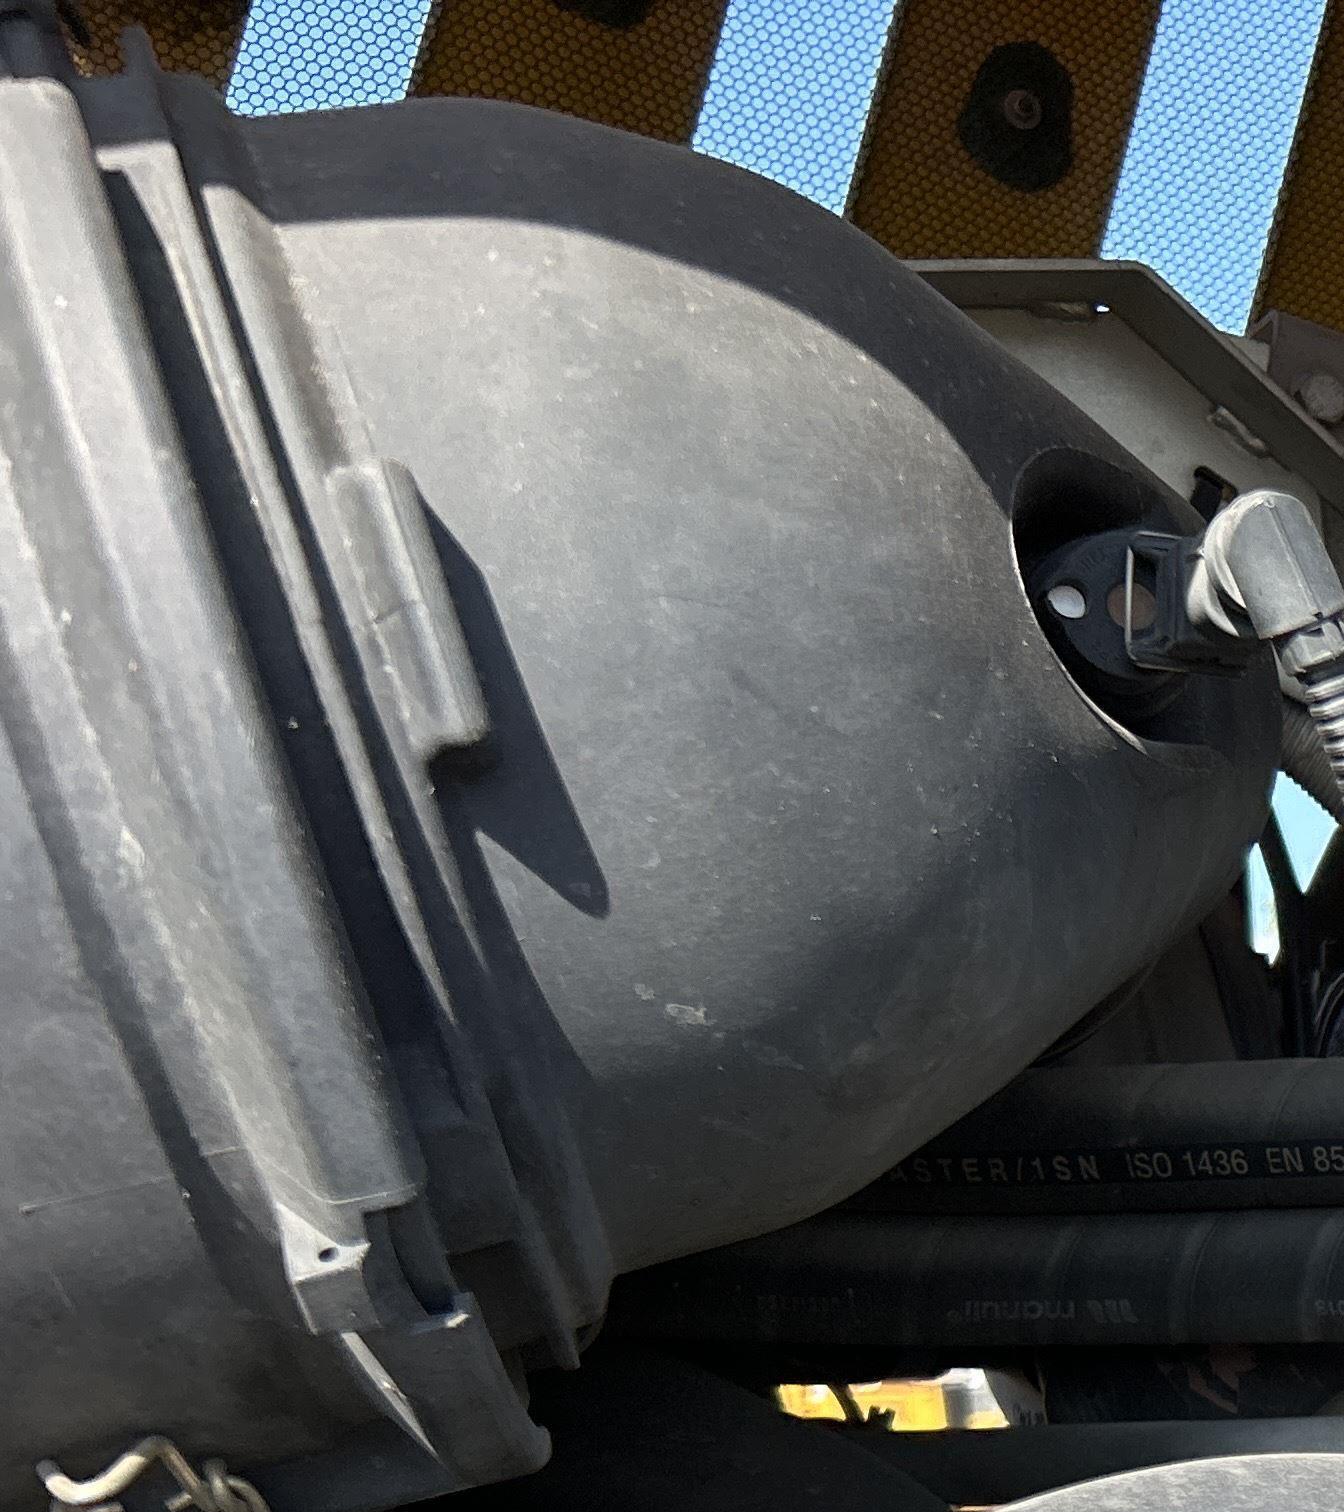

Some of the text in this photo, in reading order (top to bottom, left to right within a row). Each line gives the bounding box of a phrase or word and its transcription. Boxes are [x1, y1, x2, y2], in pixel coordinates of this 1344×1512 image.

[888, 1152, 1100, 1184] ASTER/1SN
[1125, 1150, 1173, 1180] ISO
[1183, 1147, 1249, 1178] 1436
[1265, 1146, 1302, 1174] EN
